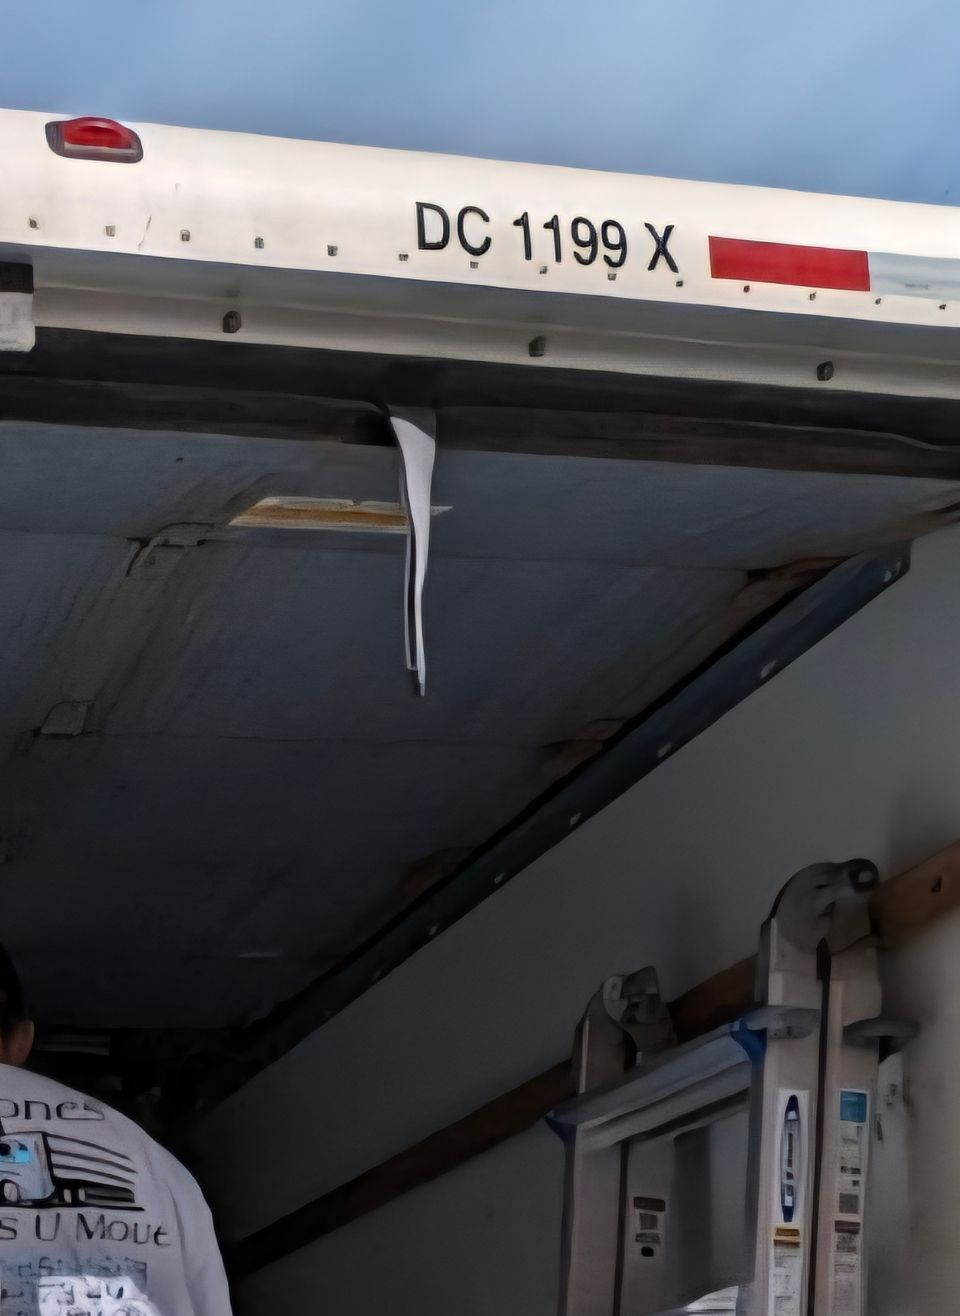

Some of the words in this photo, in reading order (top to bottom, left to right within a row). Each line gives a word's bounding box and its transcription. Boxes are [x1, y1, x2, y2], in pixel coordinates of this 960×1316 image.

[415, 201, 492, 256] DC
[513, 211, 628, 268] 1199
[643, 221, 679, 273] X
[35, 1212, 61, 1242] U
